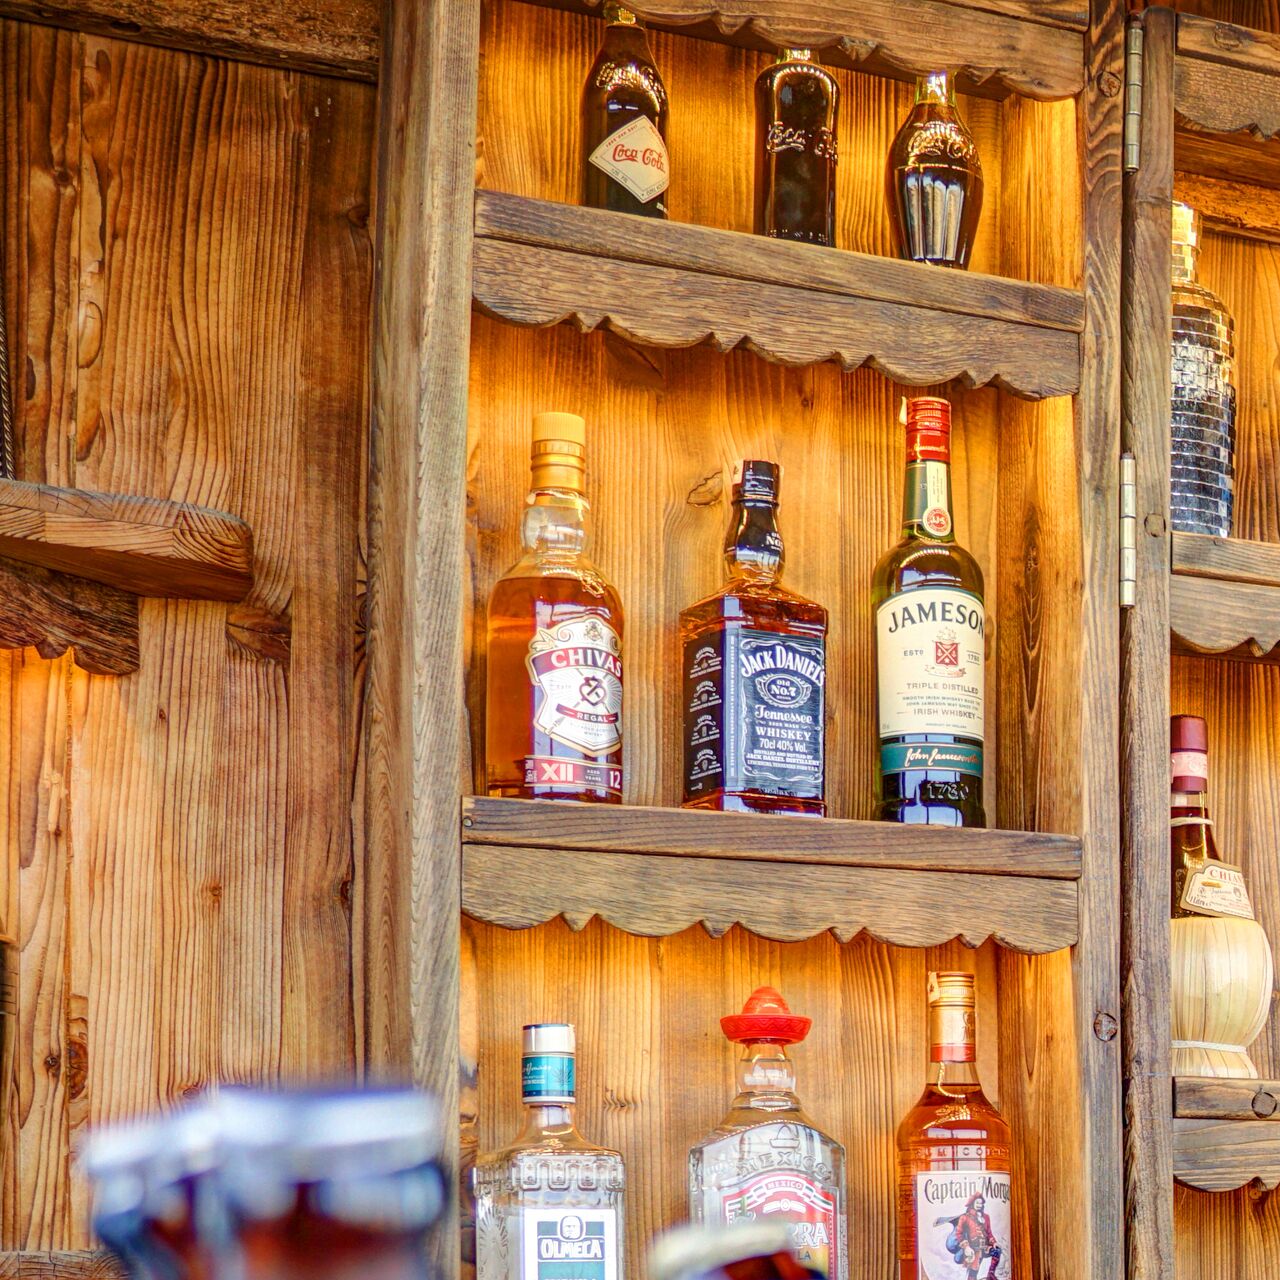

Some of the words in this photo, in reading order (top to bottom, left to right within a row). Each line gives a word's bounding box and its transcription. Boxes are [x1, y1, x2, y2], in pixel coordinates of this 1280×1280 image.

[612, 143, 666, 173] Coca-Cola
[888, 601, 985, 640] JAMESON
[551, 648, 622, 678] CHIVAS
[740, 649, 773, 678] JACK
[775, 645, 825, 687] DANIEL'S
[771, 684, 797, 697] No.7
[906, 682, 940, 690] TRIPLE
[942, 683, 979, 695] DISTILLED
[576, 712, 609, 723] REGAL
[754, 704, 813, 725] Tennessee
[913, 707, 939, 716] IRISH
[941, 708, 976, 719] WHISKEY
[755, 726, 812, 741] WHISKEY
[759, 738, 776, 749] 70cl
[776, 739, 794, 751] 40%
[795, 742, 808, 753] Vol.
[541, 762, 574, 782] XII
[609, 770, 621, 789] 12
[767, 1181, 803, 1190] MEXICO
[924, 1176, 977, 1204] Captain
[541, 1238, 603, 1259] OLMECA
